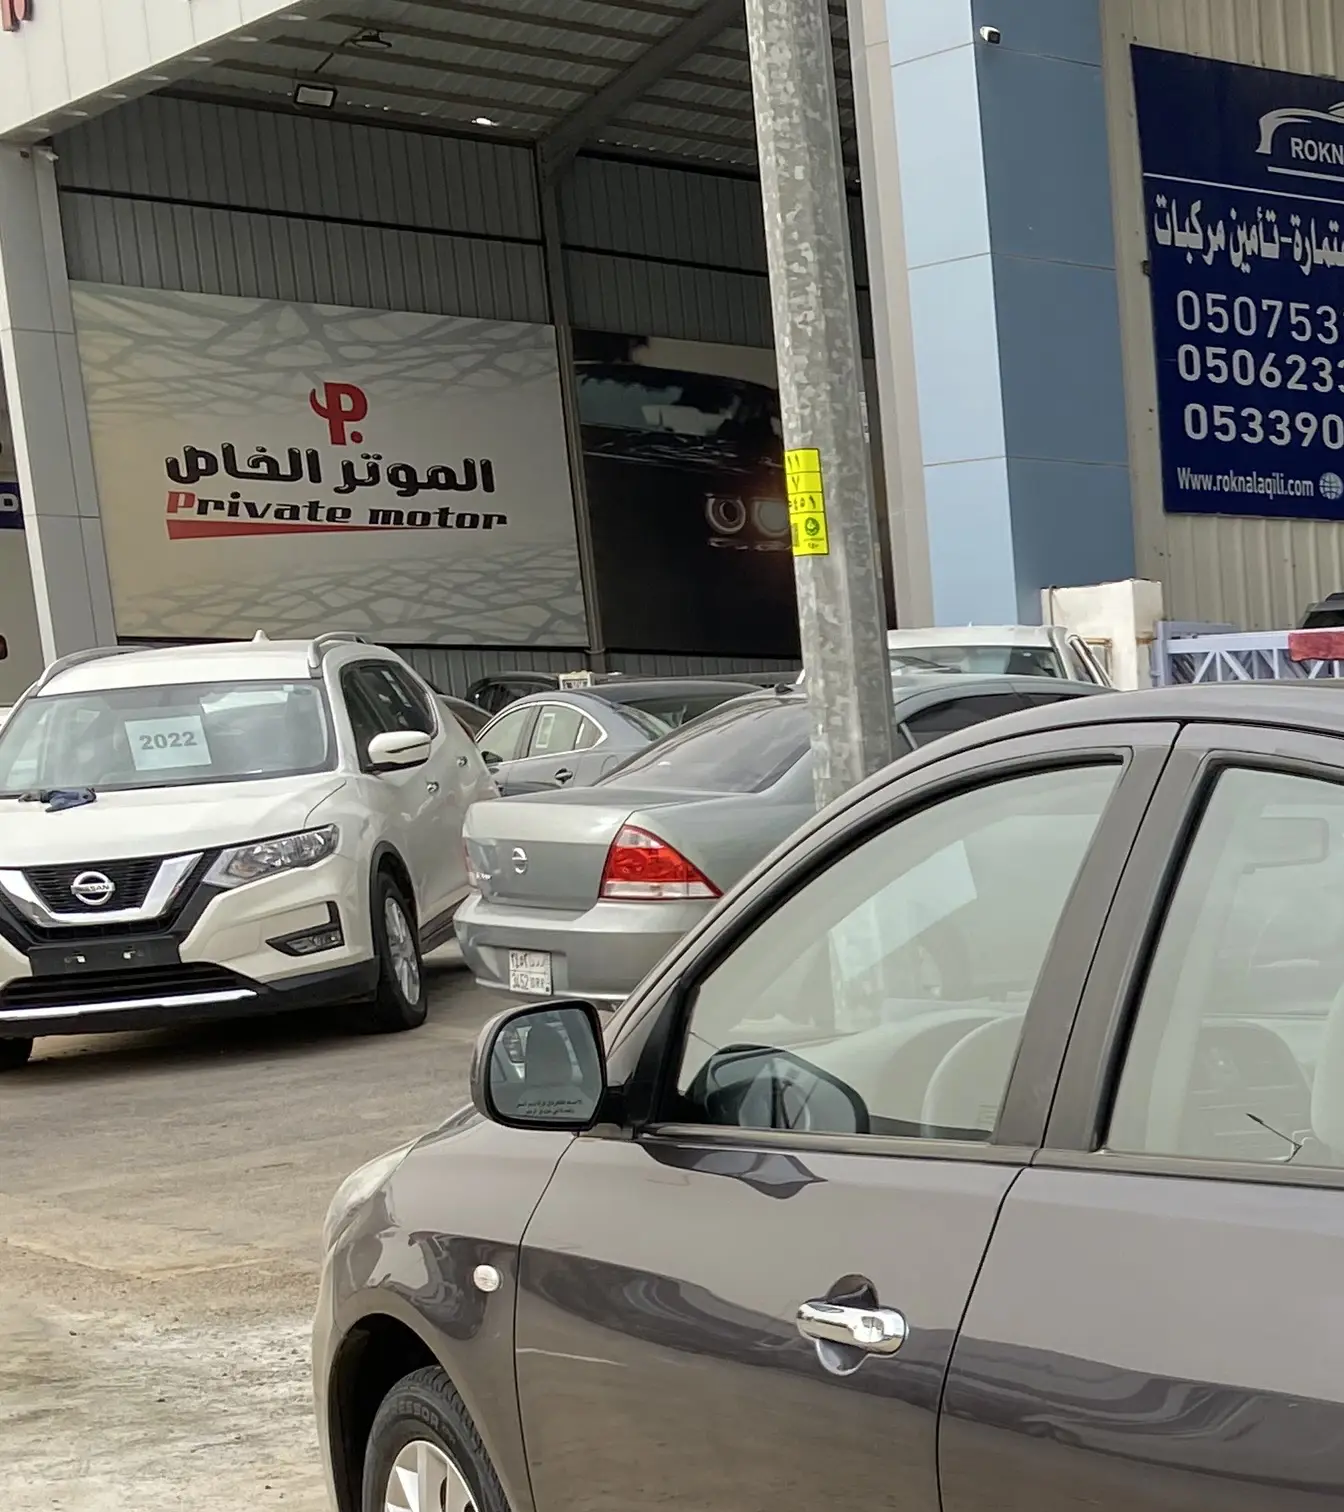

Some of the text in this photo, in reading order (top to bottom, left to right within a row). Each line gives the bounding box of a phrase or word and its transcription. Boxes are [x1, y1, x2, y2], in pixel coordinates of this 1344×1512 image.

[1290, 136, 1344, 166] ROKN
[1153, 193, 1226, 265] مركبات
[164, 441, 497, 498] الموتر الخاص
[165, 490, 508, 530] Private motor
[139, 731, 198, 750] 2022
